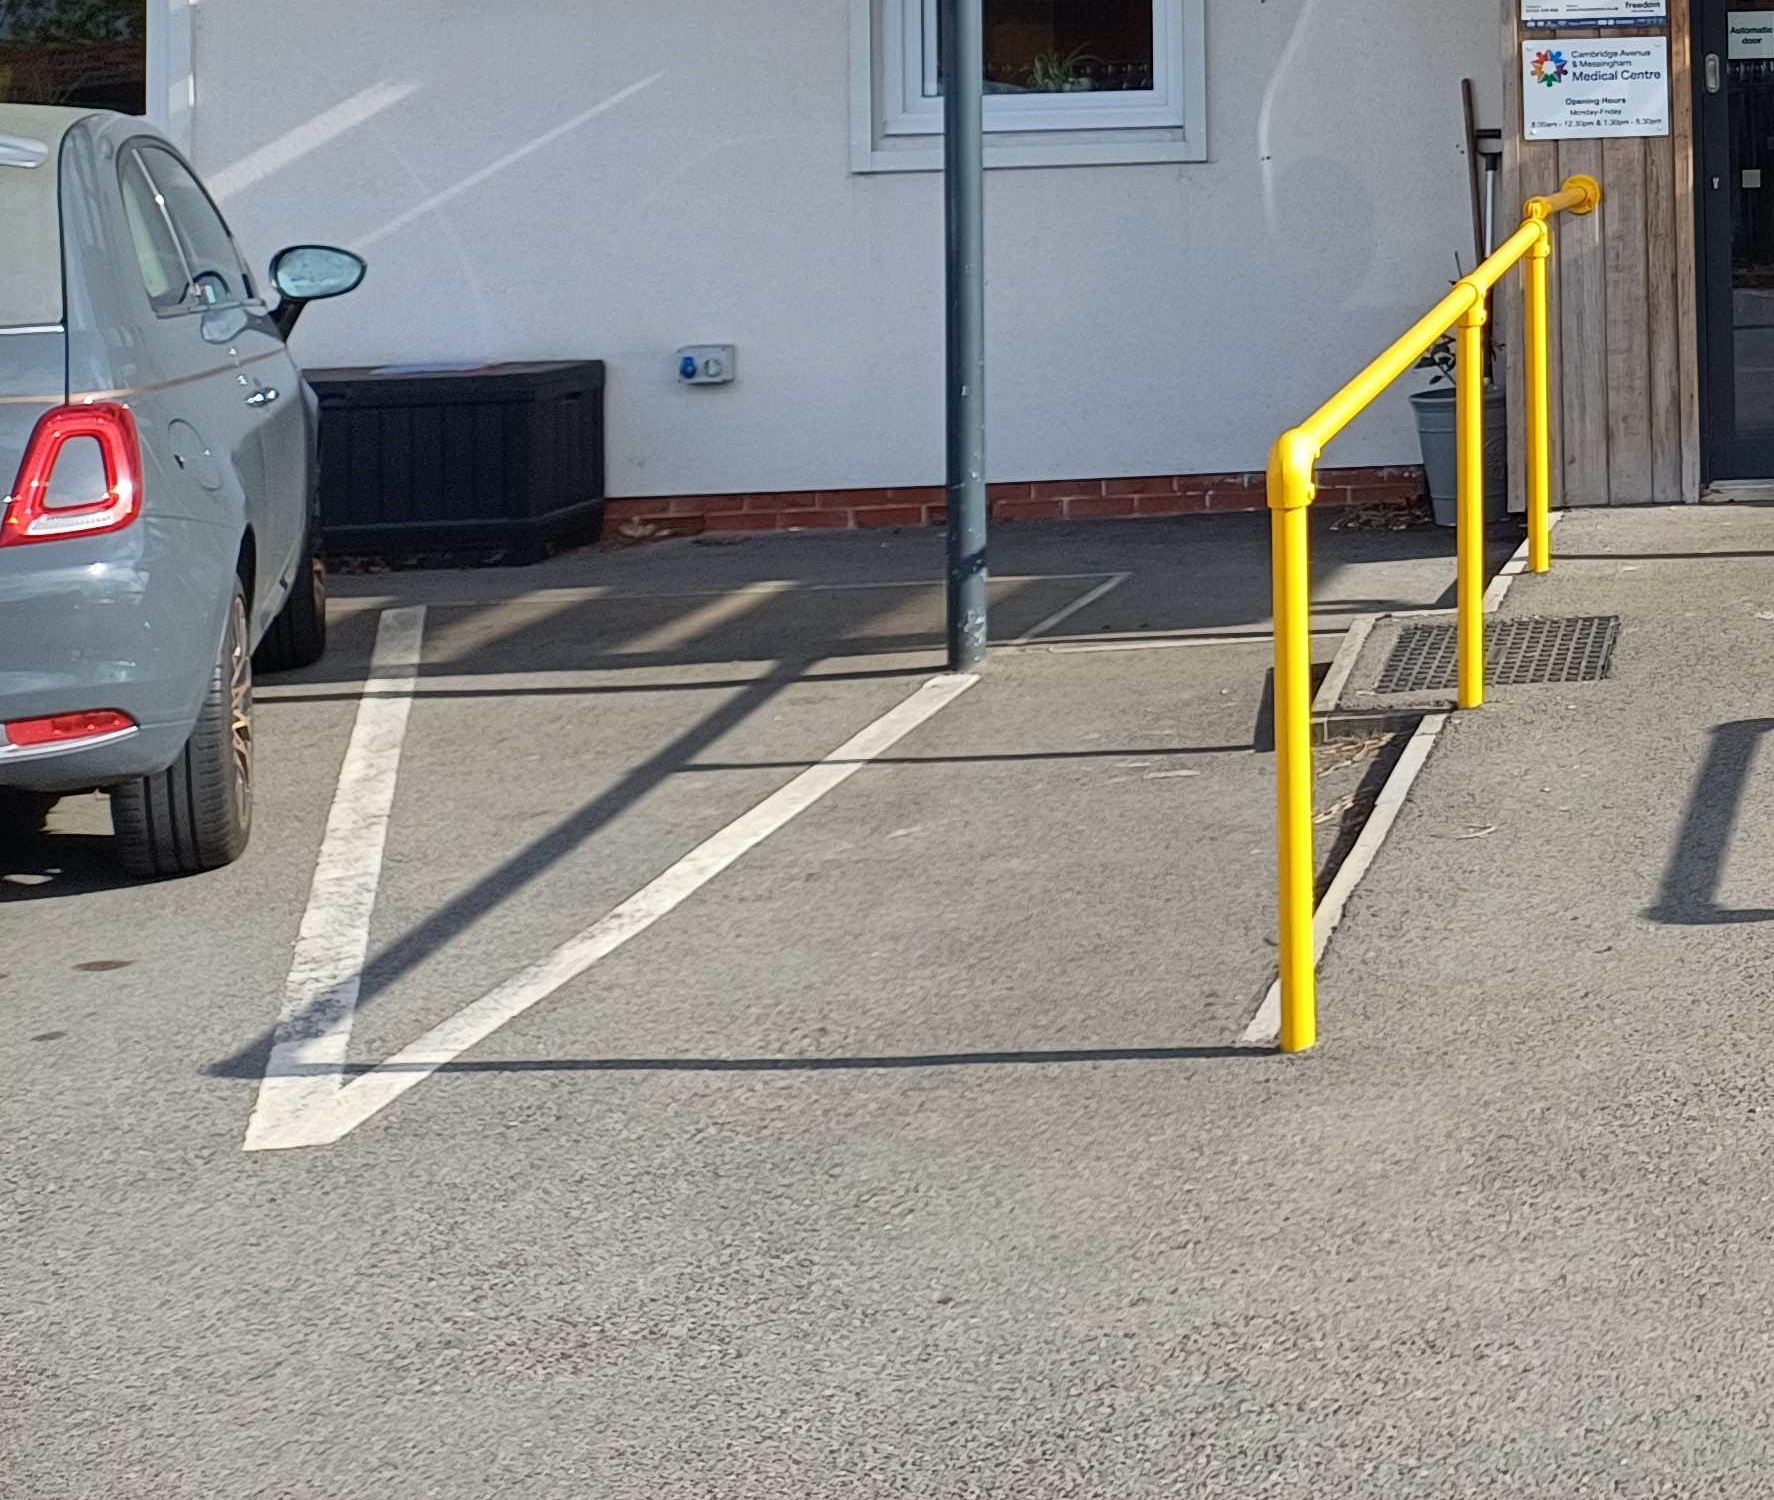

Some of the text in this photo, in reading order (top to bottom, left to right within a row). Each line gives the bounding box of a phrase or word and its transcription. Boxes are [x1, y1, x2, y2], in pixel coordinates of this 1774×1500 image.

[1730, 26, 1773, 34] Automatic
[1741, 37, 1763, 45] door
[1571, 50, 1619, 59] Cambridge
[1580, 60, 1632, 68] Messingham
[1572, 69, 1661, 81] Medical Centre
[1564, 97, 1600, 105] Opening
